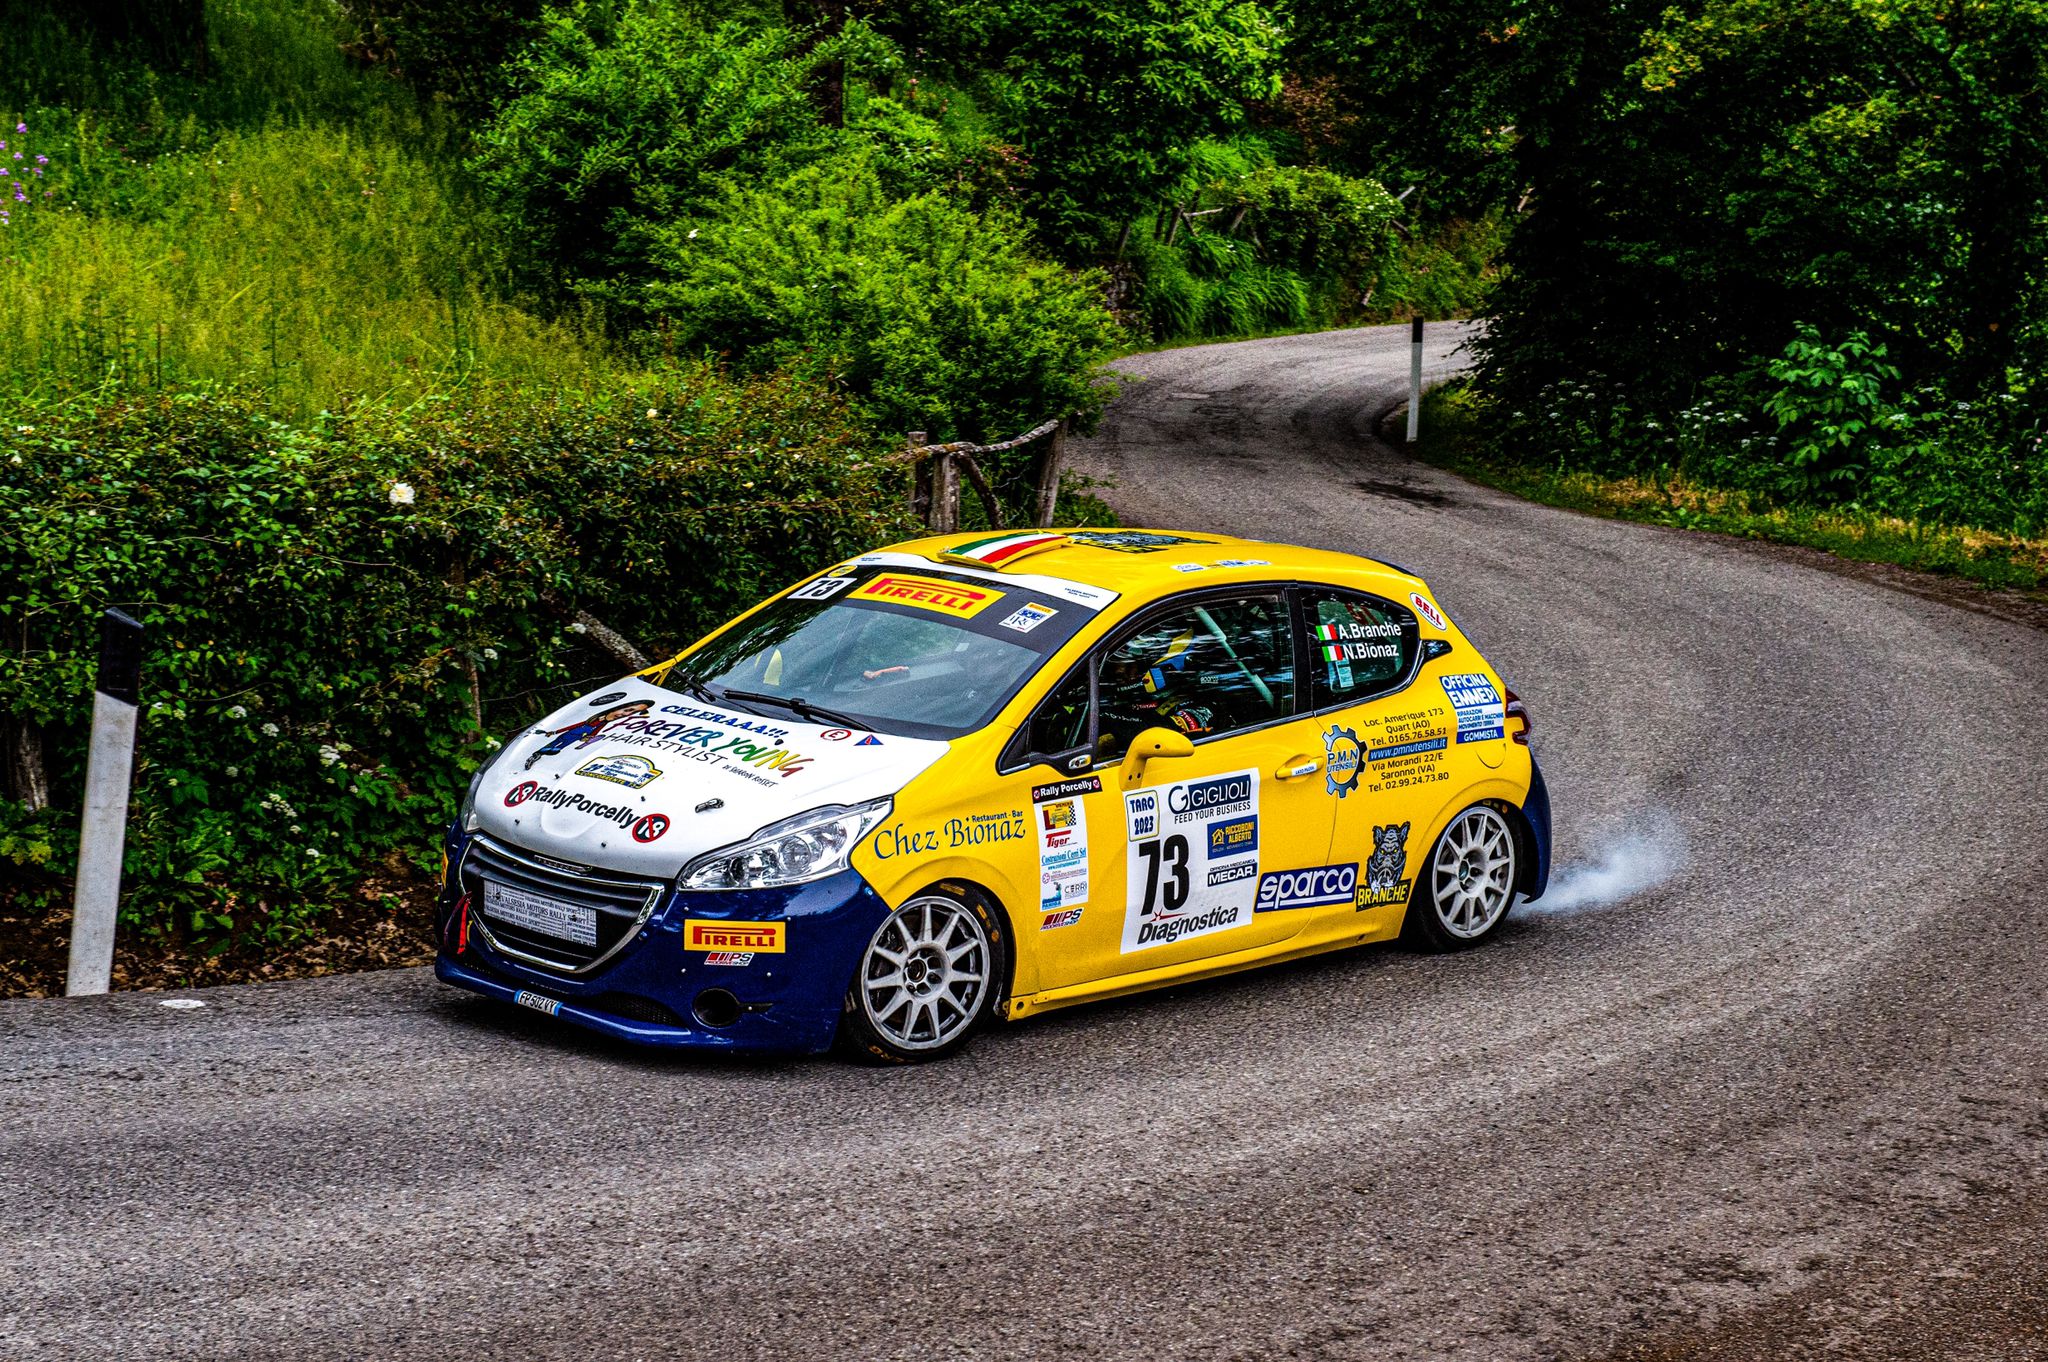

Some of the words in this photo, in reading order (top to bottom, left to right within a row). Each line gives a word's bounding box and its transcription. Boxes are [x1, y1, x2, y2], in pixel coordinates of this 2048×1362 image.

[799, 580, 844, 597] 73
[863, 577, 986, 611] PIRELLI
[1415, 596, 1443, 625] BELL
[1338, 622, 1402, 640] A.Branche
[1343, 643, 1399, 660] N.Bionaz
[1441, 674, 1491, 690] OFFICINA
[1447, 686, 1500, 708] EMMEPI
[660, 705, 789, 738] CELERAAA!!!
[1363, 719, 1382, 728] Loc.
[1384, 711, 1426, 724] Amerique
[1427, 707, 1444, 717] 173
[1385, 723, 1410, 734] Quart
[1412, 719, 1430, 730] (AO)
[602, 716, 724, 747] FOREVER
[1371, 736, 1386, 746] Tel.
[1388, 727, 1447, 744] 0165.76.58.51
[1463, 729, 1498, 742] GOMMISTA
[602, 733, 652, 746] HAIR
[649, 740, 728, 765] STYLIST
[710, 737, 815, 778] YOUNG
[1327, 748, 1358, 765] P.M.N
[1370, 738, 1446, 759] www.pmnutensili.it
[1372, 763, 1385, 772] Via
[1387, 756, 1422, 769] Morandi
[1424, 752, 1443, 763] 22/E
[1381, 768, 1415, 780] Saronno
[1417, 763, 1435, 774] (VA)
[1040, 786, 1060, 797] Rally
[1060, 780, 1092, 793] Porcelly
[1368, 783, 1383, 793] Tel.
[1385, 771, 1449, 790] 02.99.24.73.80
[1191, 780, 1250, 807] GIGLIOLI
[529, 786, 641, 830] RallyPorcelly
[1130, 796, 1155, 814] TARO
[1174, 813, 1193, 825] FEED
[1195, 808, 1215, 820] YOUR
[1216, 801, 1251, 816] BUSINESS
[971, 812, 1007, 823] Restaurant
[1012, 810, 1023, 818] Bar
[1134, 816, 1154, 836] 2023
[873, 824, 939, 859] Chez
[944, 818, 1025, 848] Bionaz
[1045, 830, 1072, 849] Tiger
[1228, 831, 1252, 843] ALBERTO
[1138, 834, 1190, 917] 73
[1209, 865, 1253, 885] MECAR
[1260, 867, 1354, 909] sparco
[1357, 884, 1408, 907] BRANCHE
[1137, 906, 1239, 945] Diagnostica
[693, 926, 776, 947] PIRELLI
